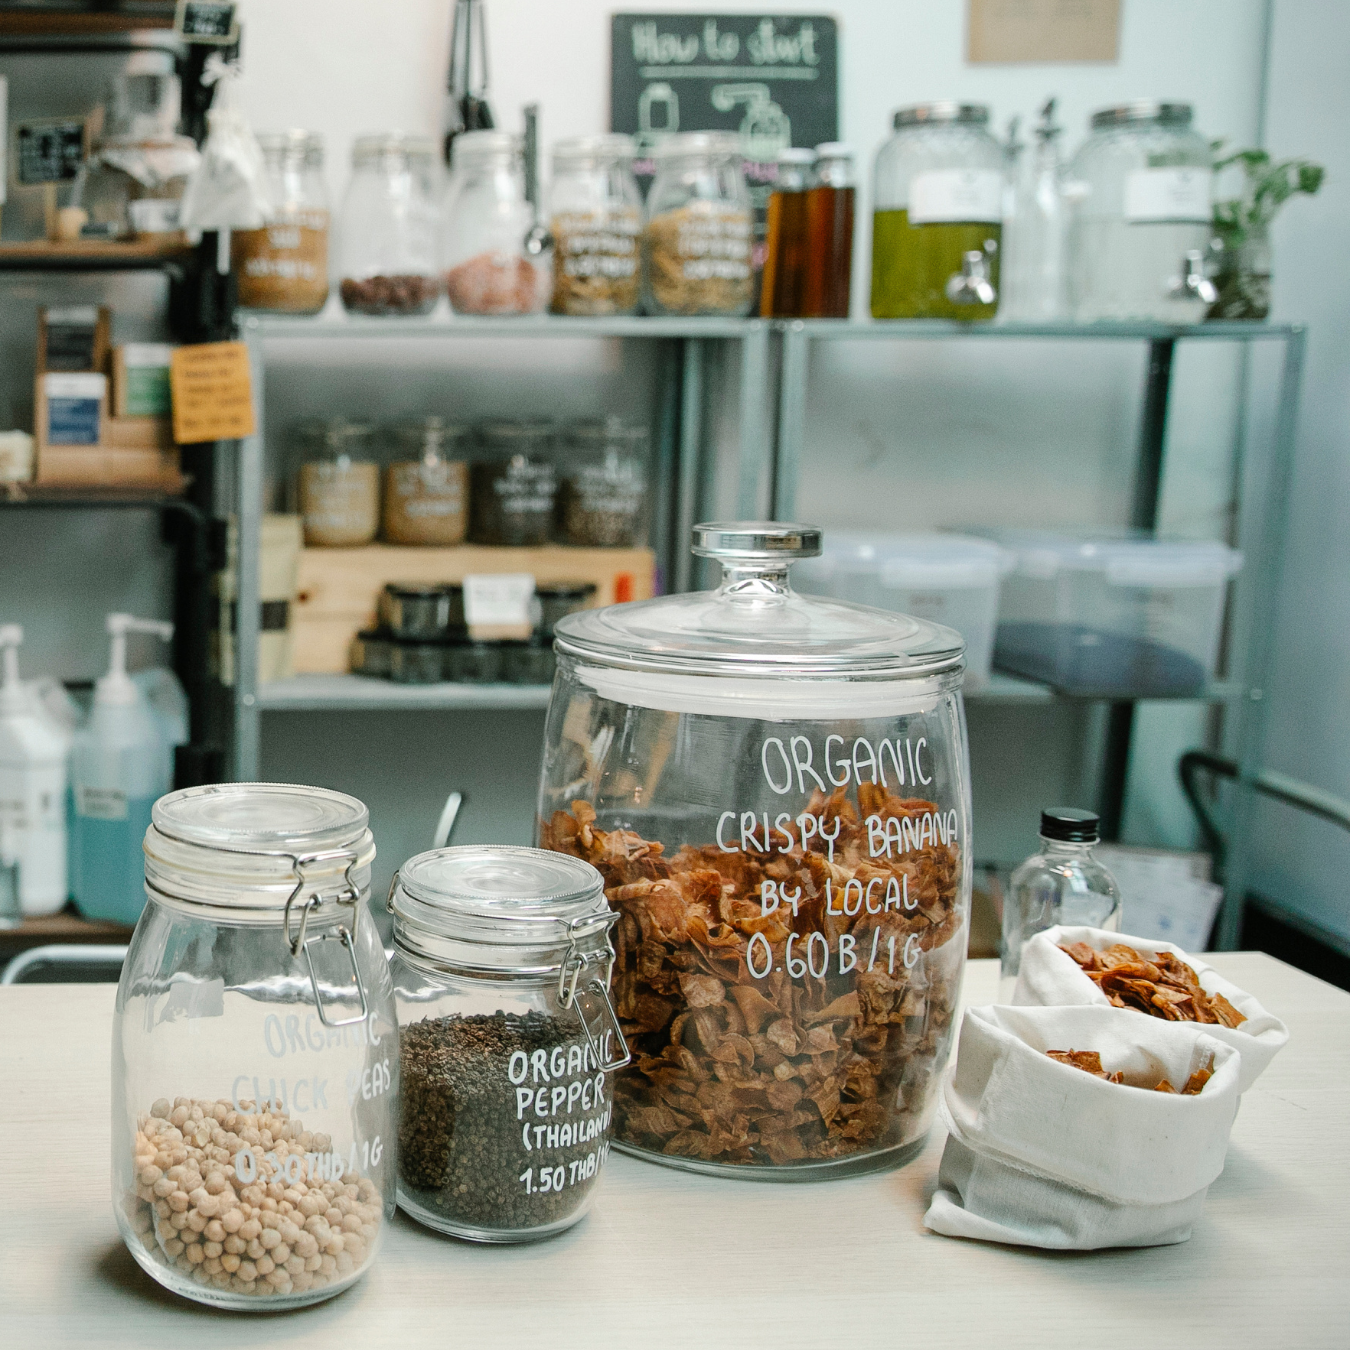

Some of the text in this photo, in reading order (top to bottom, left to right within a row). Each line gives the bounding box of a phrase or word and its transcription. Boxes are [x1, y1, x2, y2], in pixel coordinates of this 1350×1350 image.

[632, 20, 700, 64] How
[704, 18, 740, 61] to
[761, 734, 932, 795] ORGANIC
[716, 809, 958, 862] CRISPY BANANA
[761, 874, 919, 917] BY LOCAL
[264, 1011, 382, 1058] ORGANIC
[508, 1029, 613, 1085] ORGANIC
[232, 1058, 391, 1118] CHICK PEAS
[516, 1072, 605, 1120] PEPPER
